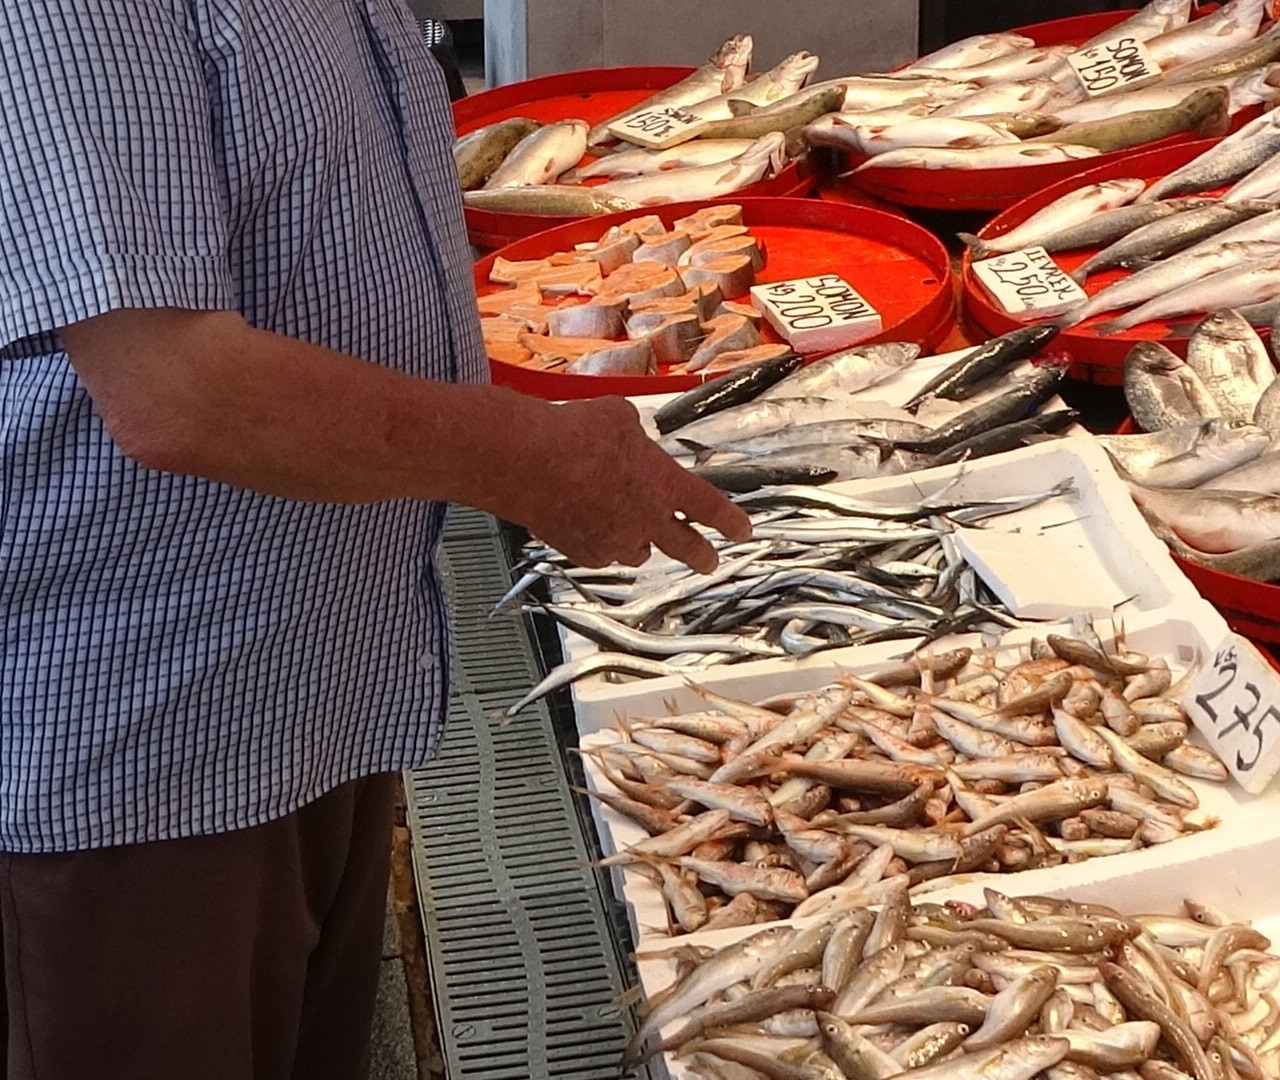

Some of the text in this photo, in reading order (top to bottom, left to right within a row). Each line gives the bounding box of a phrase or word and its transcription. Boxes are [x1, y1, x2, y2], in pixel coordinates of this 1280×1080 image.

[1077, 59, 1118, 91] 150
[624, 111, 671, 132] 150
[988, 261, 1049, 296] 250
[1023, 250, 1077, 300] LEVREK
[767, 294, 833, 330] 200
[806, 276, 879, 321] SOMON
